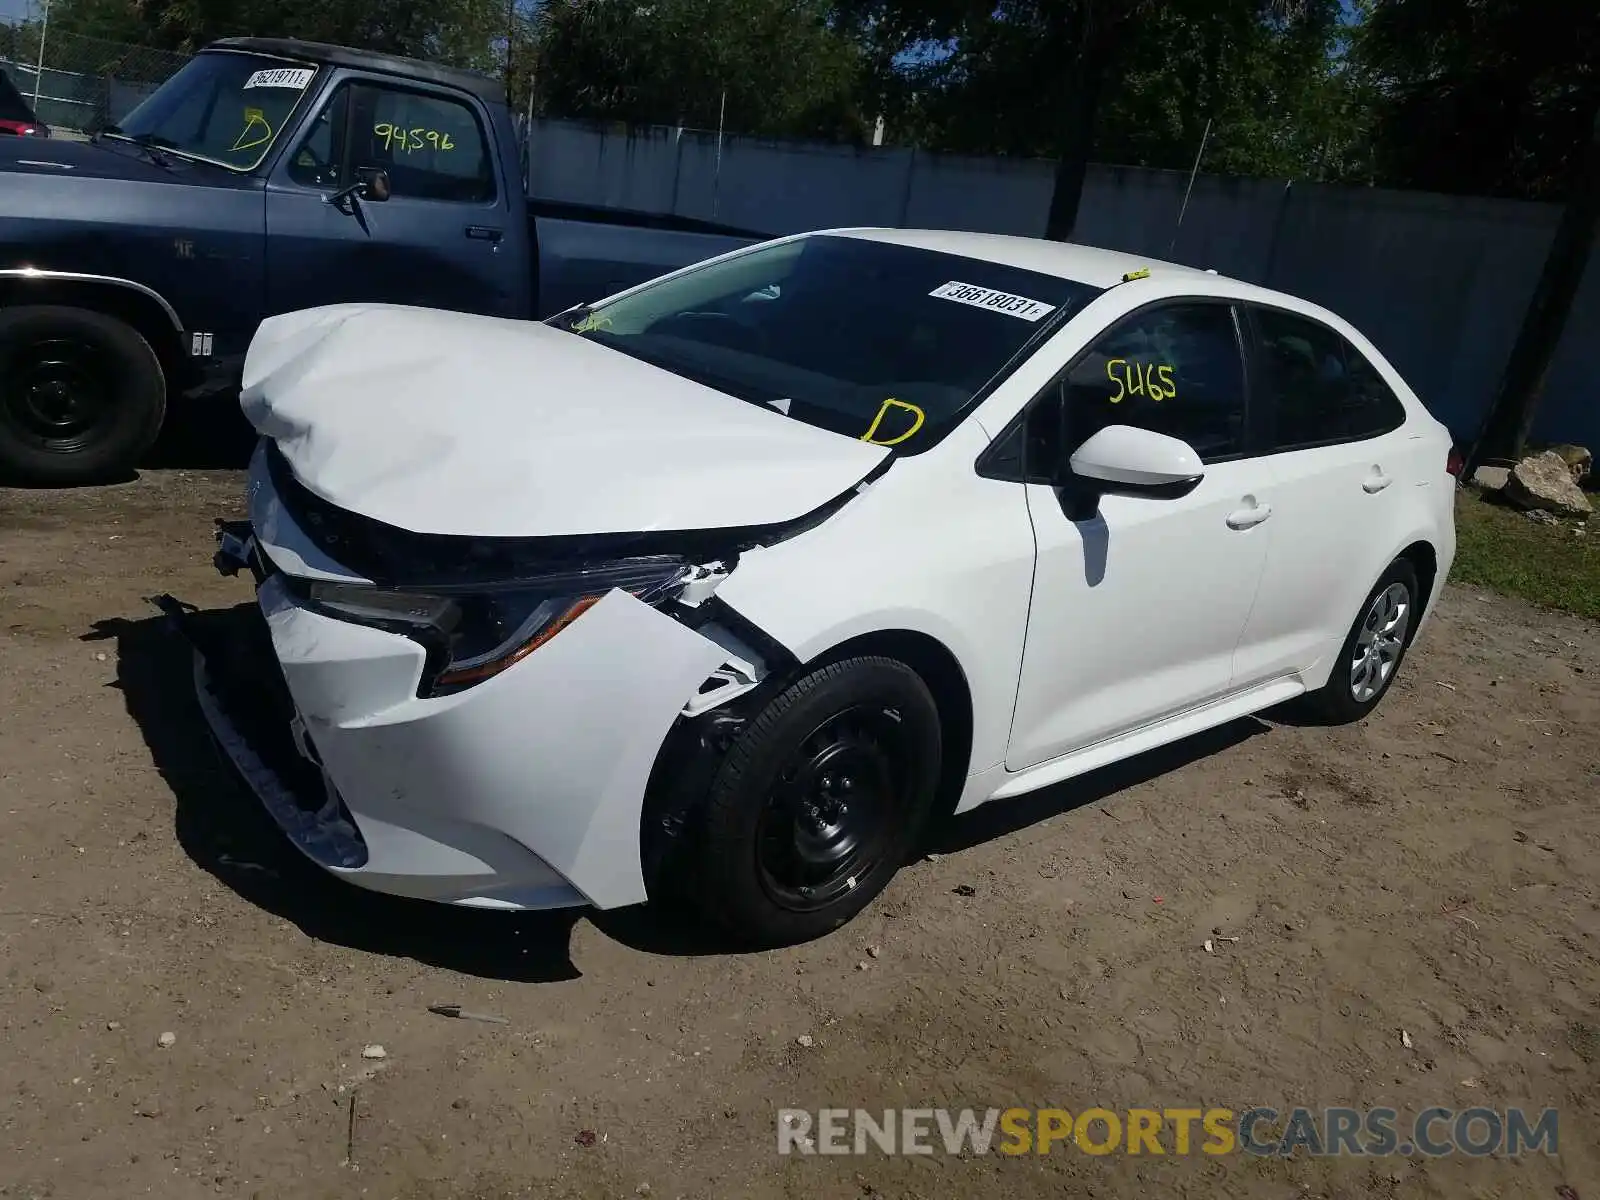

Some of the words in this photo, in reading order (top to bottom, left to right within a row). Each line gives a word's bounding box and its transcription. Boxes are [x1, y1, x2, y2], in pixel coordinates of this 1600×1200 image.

[374, 123, 455, 155] 94,596
[946, 284, 1037, 314] 36618031
[861, 398, 925, 445] D
